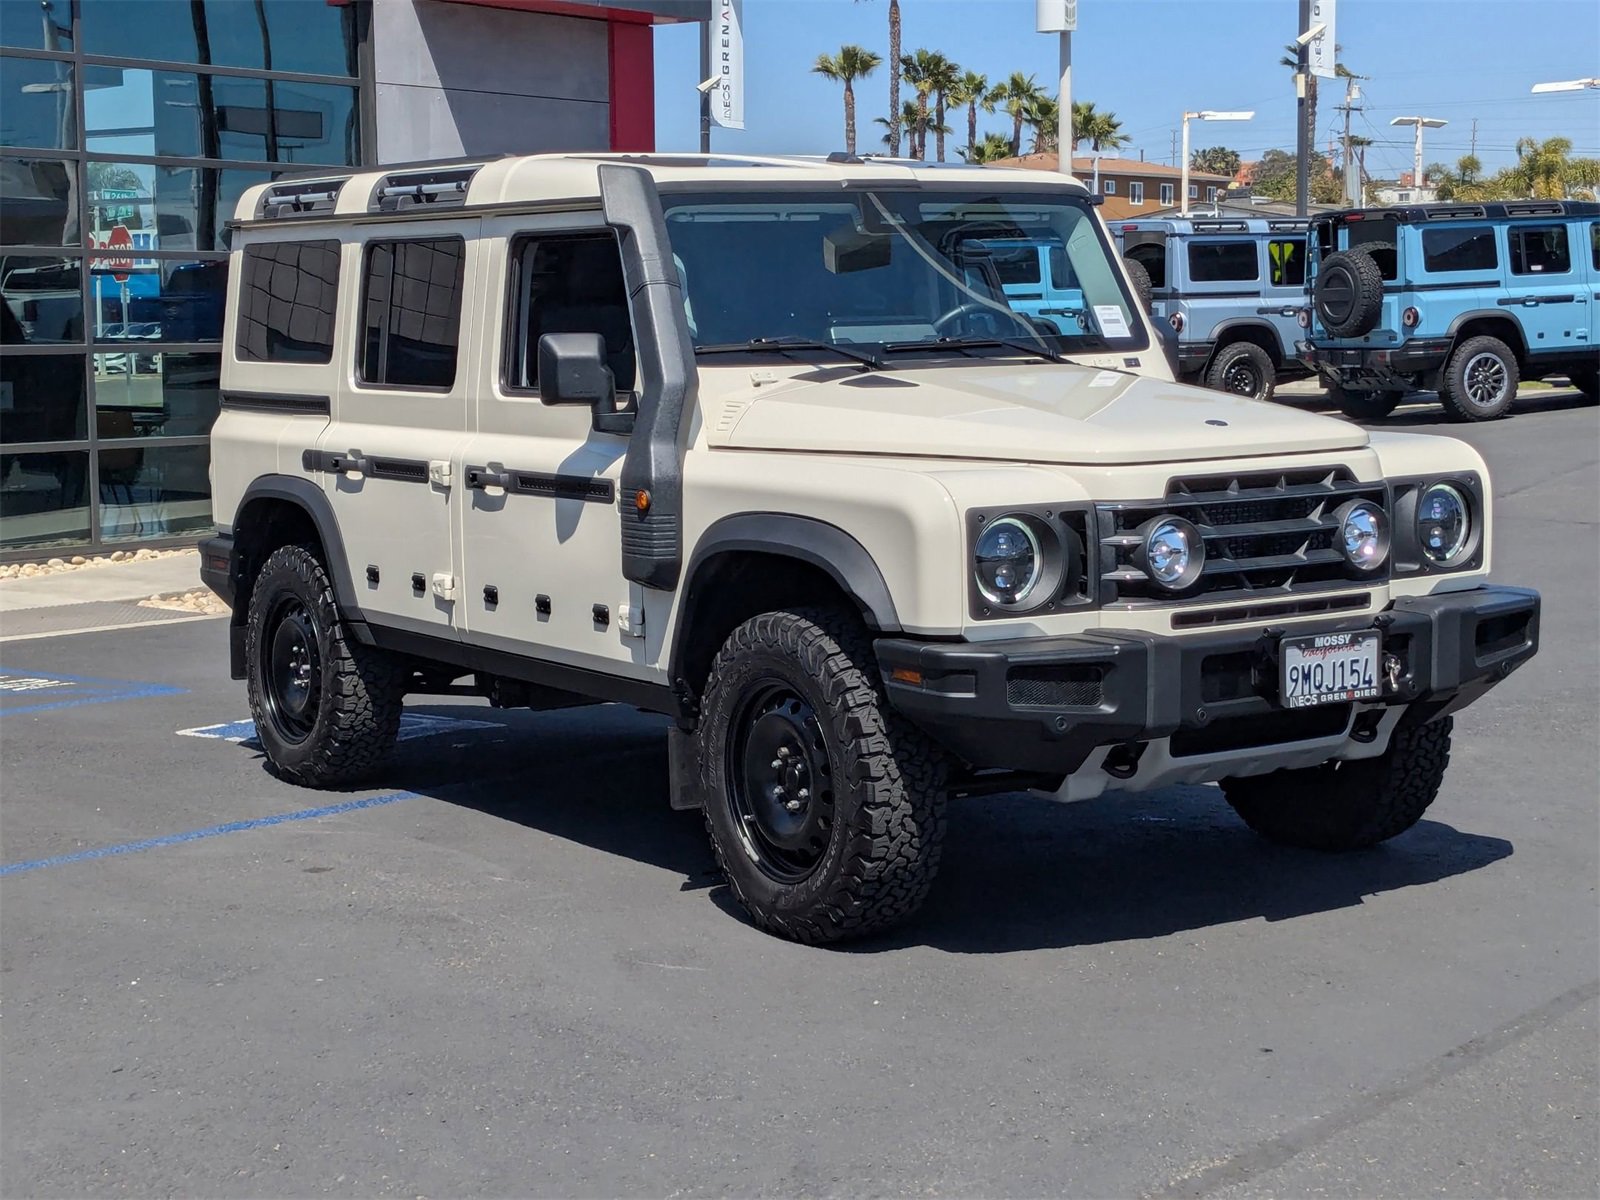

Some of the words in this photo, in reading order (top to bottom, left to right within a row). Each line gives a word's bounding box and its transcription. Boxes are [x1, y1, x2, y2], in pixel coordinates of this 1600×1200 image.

[722, 84, 731, 119] INEOS
[1314, 634, 1352, 648] MOSSY
[1288, 657, 1374, 697] 9MQJ154
[1289, 694, 1318, 708] INEOS
[1320, 688, 1377, 702] GRENADIER
